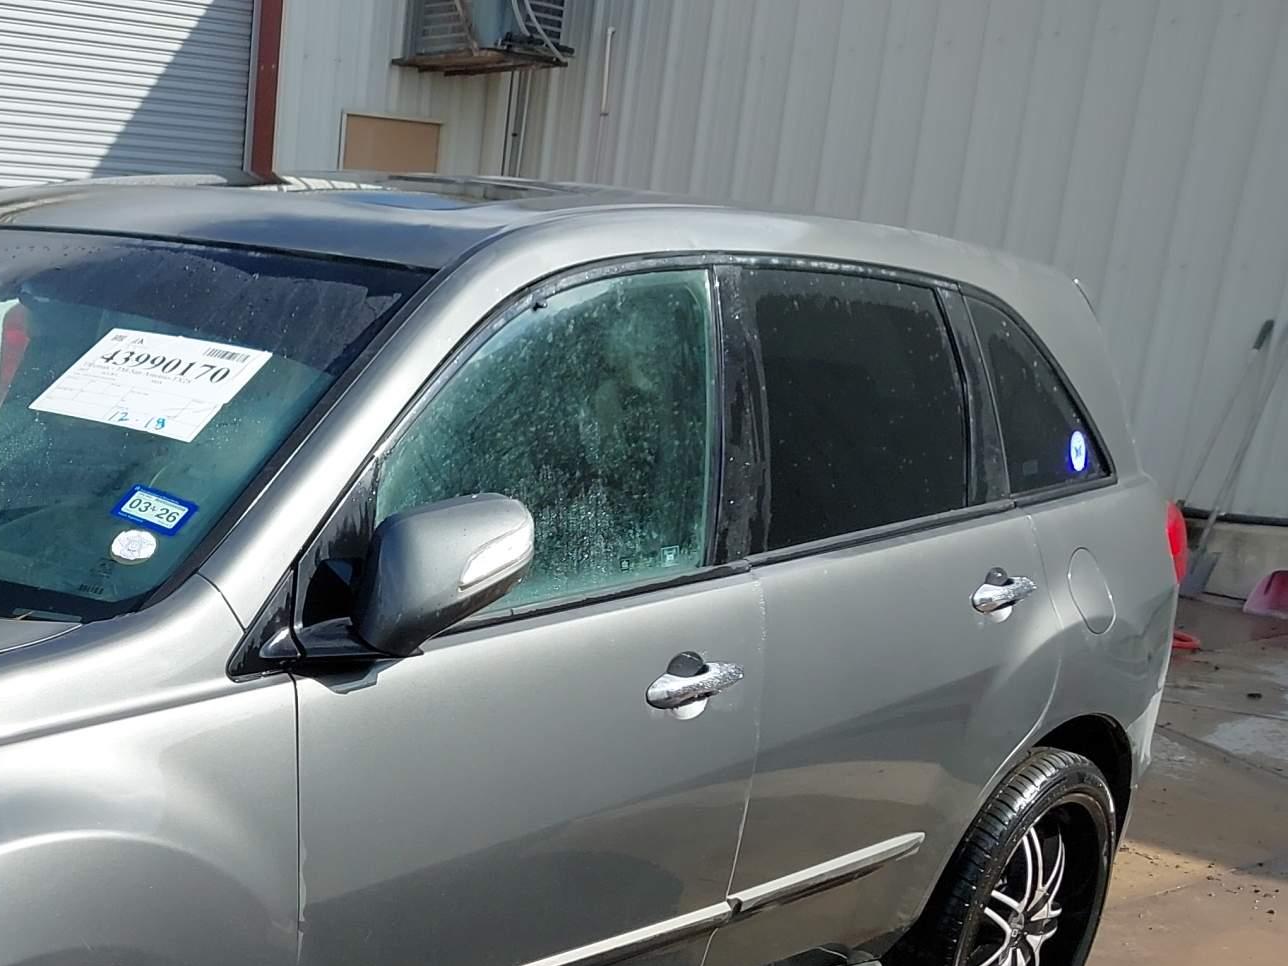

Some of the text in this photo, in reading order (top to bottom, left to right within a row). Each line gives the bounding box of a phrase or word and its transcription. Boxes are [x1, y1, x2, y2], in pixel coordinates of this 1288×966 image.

[100, 349, 232, 384] 43990170
[128, 498, 152, 513] 03
[154, 507, 180, 523] 26
